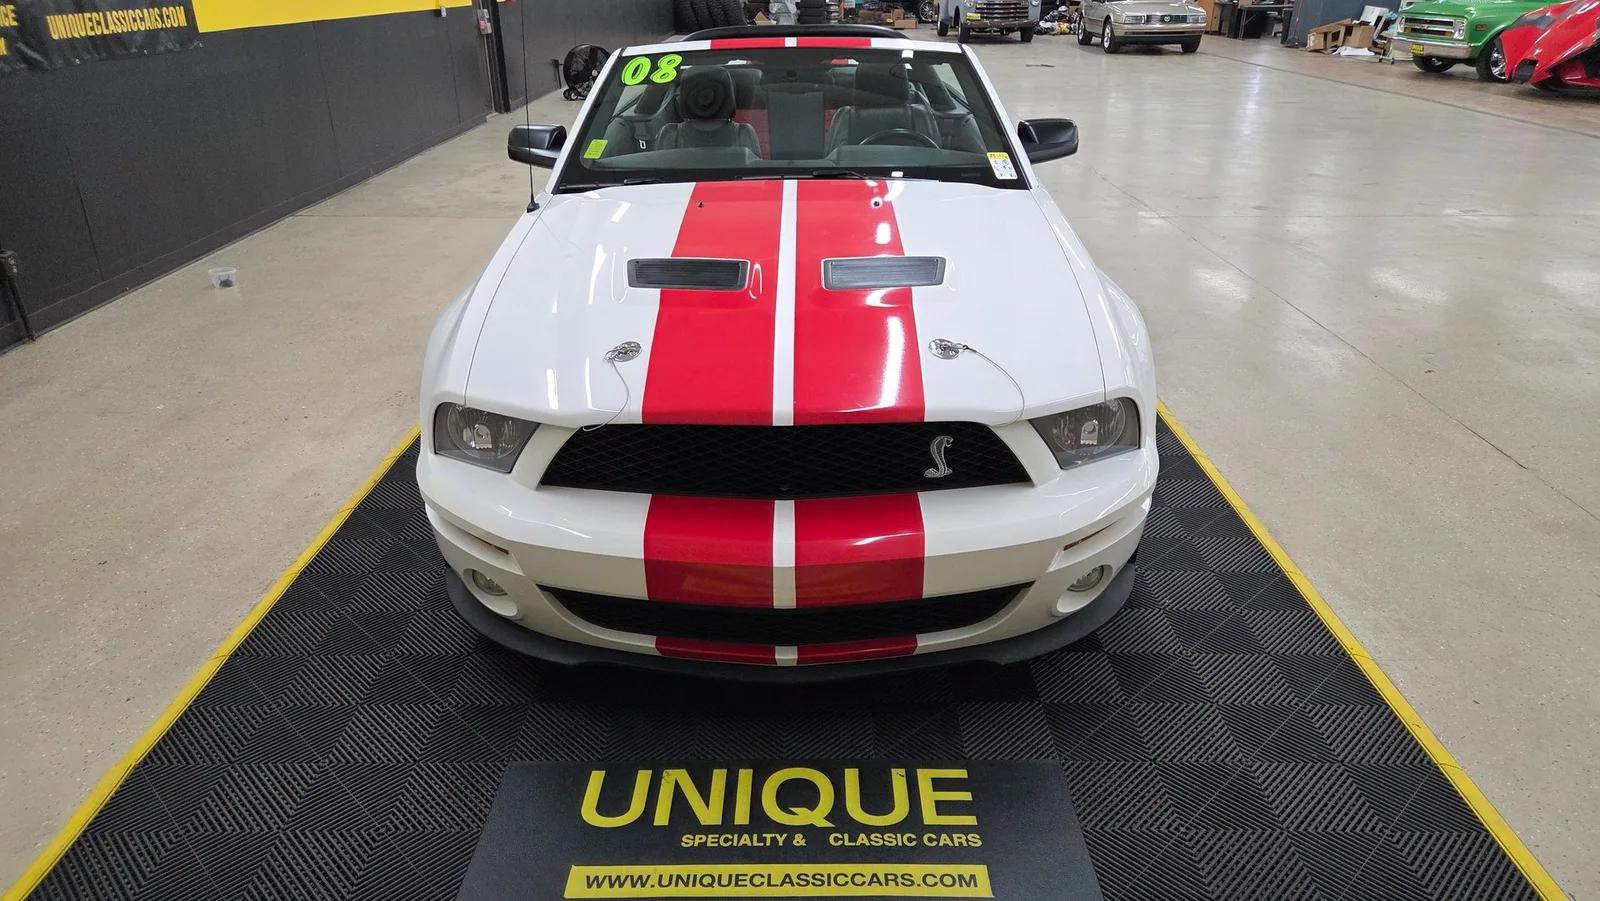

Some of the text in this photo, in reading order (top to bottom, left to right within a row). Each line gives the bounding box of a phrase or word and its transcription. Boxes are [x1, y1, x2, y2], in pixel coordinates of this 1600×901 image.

[46, 6, 187, 40] UNIQUECLASSICCARS.COM
[621, 53, 683, 86] 08
[581, 766, 978, 827] UNIQUE
[681, 832, 982, 848] SPECIALTY & CLASSIC CARS
[585, 872, 978, 889] WWW.UNIQUECLASSICCARS.COM
